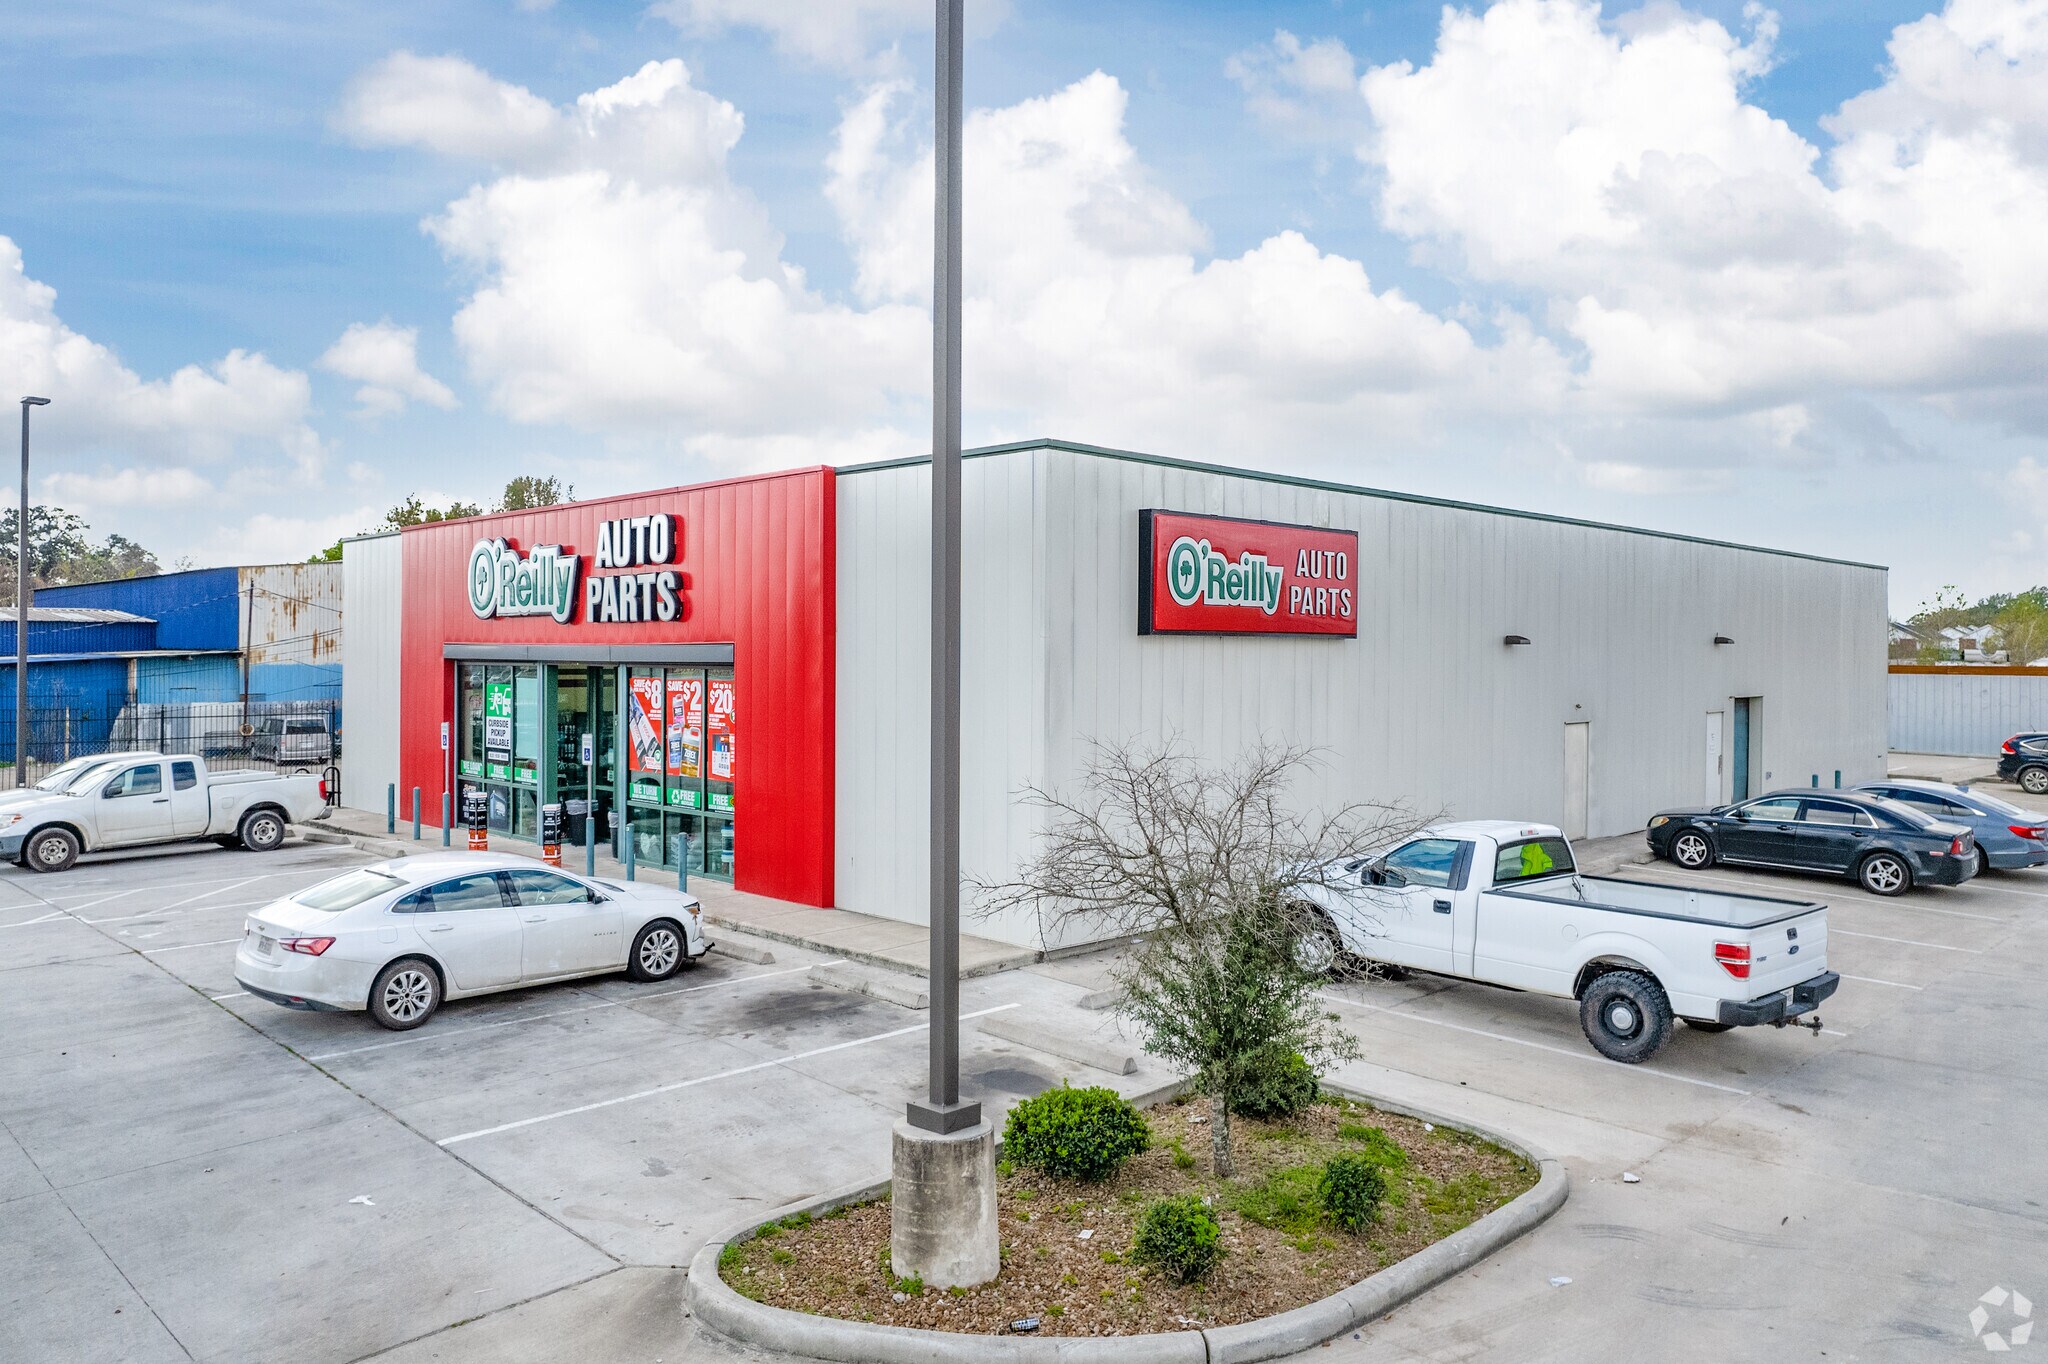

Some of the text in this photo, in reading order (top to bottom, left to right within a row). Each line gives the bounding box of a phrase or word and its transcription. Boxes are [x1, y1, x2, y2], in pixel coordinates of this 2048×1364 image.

[595, 513, 669, 569] AUTO
[1170, 541, 1281, 611] O'Reilly
[1296, 549, 1347, 580] AUTO
[469, 543, 575, 618] O'Reilly
[586, 571, 678, 623] PARTS
[1290, 586, 1351, 616] PARTS
[634, 679, 661, 709] SAVE $8
[667, 681, 701, 711] SAVE $2
[709, 689, 733, 714] $20
[488, 719, 509, 728] CURBSIDE
[491, 729, 506, 737] PICKUP
[487, 738, 509, 747] AVAILABLE
[680, 790, 695, 801] FREE
[712, 794, 728, 806] FREE
